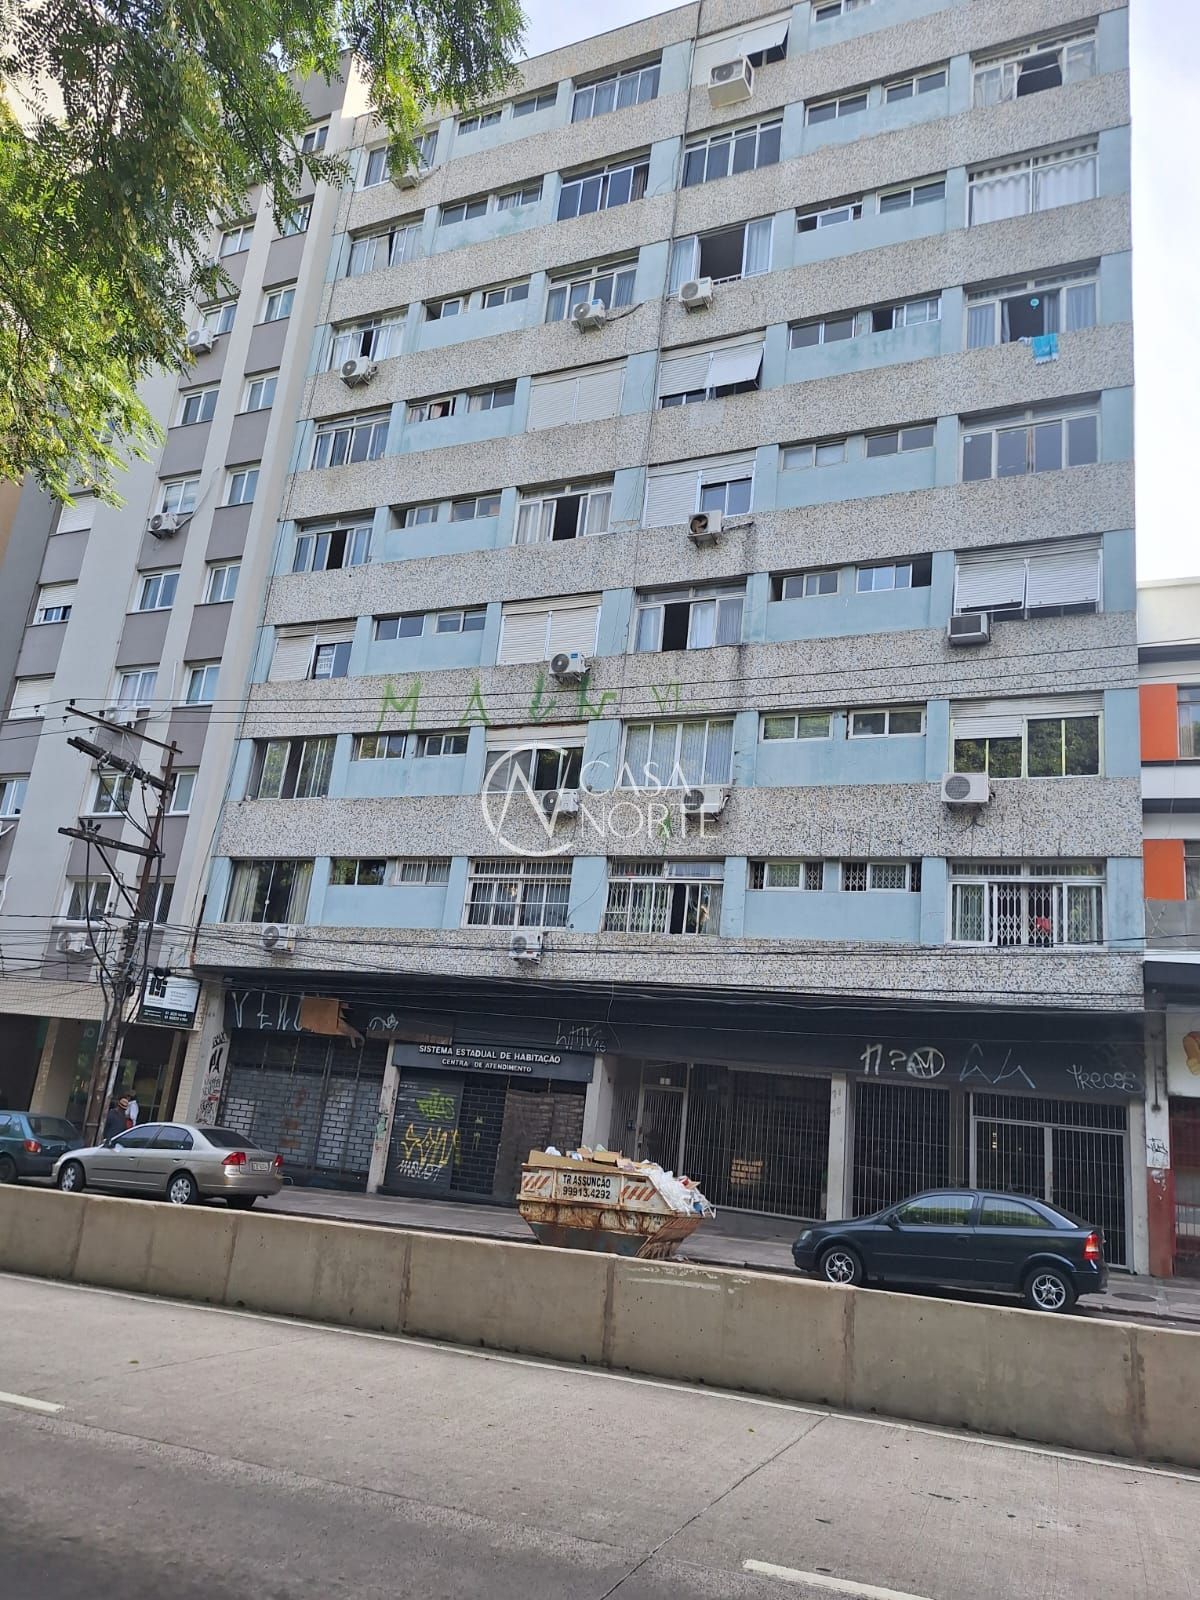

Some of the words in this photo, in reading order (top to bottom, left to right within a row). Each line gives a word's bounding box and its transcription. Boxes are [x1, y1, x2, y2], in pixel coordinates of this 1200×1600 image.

[419, 1045, 453, 1055] SISTEMA
[456, 1047, 497, 1059] ESTADUAL
[499, 1051, 512, 1060] DE
[485, 1062, 532, 1073] ATENDIMENTO
[562, 1174, 572, 1184] TR
